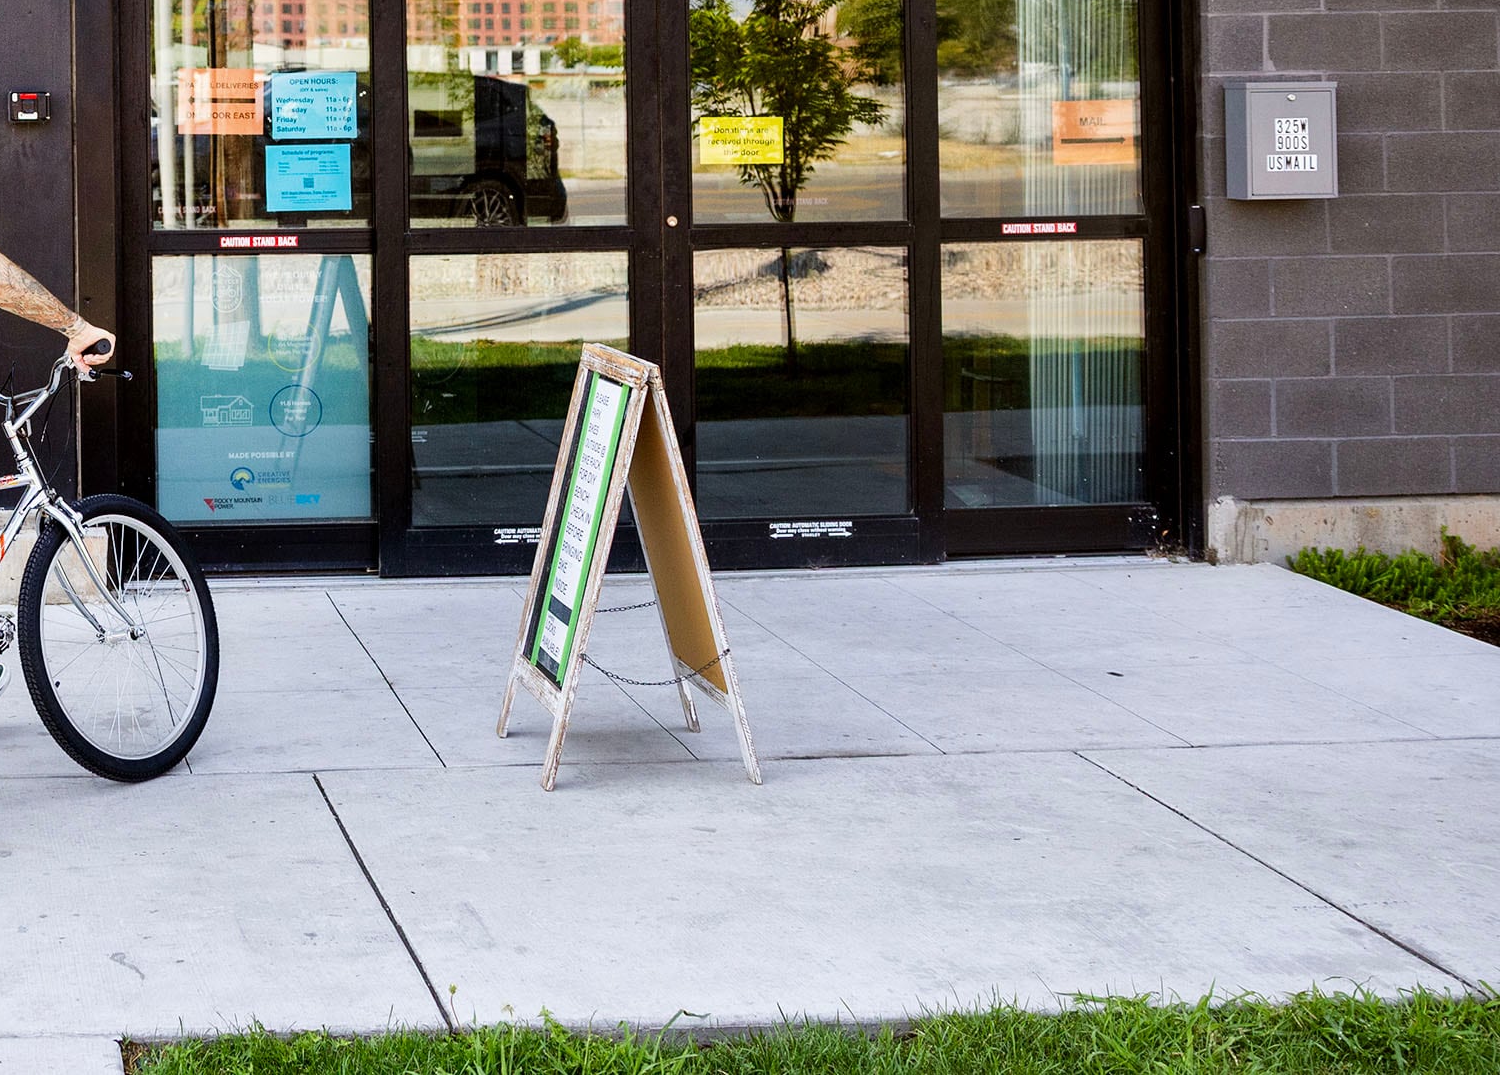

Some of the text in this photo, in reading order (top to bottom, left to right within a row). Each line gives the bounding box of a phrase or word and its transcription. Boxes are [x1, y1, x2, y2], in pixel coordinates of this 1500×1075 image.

[276, 96, 314, 104] Wednesday
[1079, 117, 1106, 126] MAIL
[743, 137, 775, 146] through
[740, 148, 759, 156] door
[1002, 222, 1077, 233] CAUTION STAND BACK
[220, 236, 297, 247] CAUTION STAND BACK
